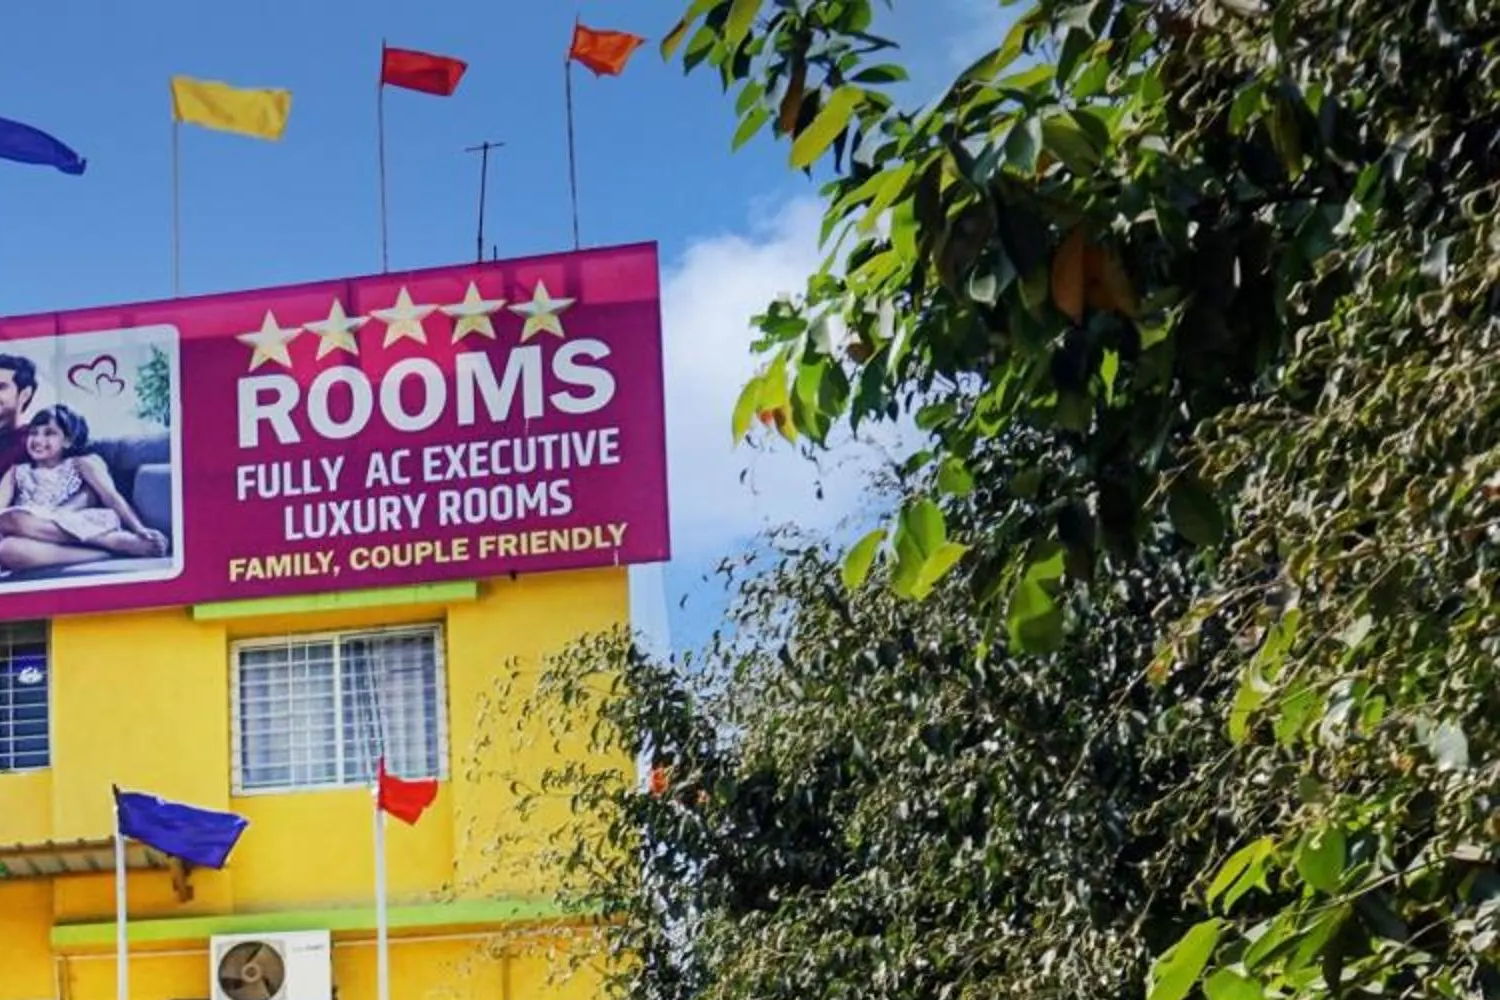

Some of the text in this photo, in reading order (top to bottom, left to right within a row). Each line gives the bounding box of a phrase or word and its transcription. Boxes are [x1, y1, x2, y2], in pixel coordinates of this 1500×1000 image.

[236, 338, 617, 450] ROOMS
[236, 427, 621, 501] FULLY AC EXECUTIVE
[284, 478, 574, 541] LUXURY ROOMS
[228, 522, 630, 582] FAMILY, COUPLE FRIENDLY
